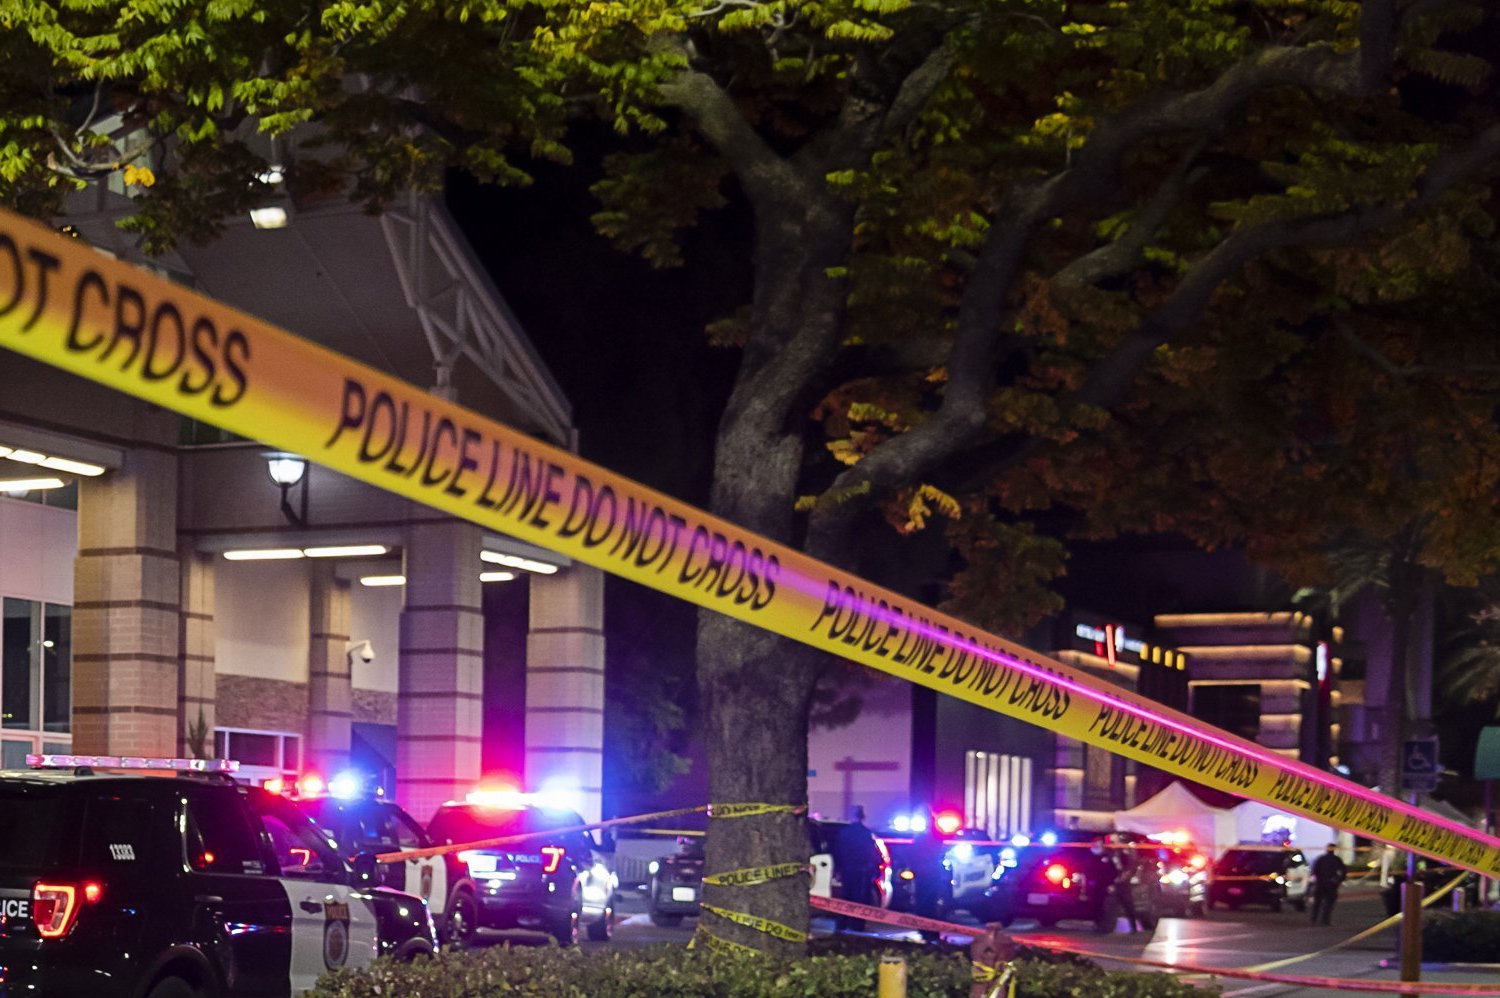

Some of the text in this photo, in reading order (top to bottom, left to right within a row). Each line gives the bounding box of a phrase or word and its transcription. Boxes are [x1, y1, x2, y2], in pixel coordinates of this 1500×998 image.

[66, 270, 252, 409] CROSS
[324, 377, 781, 611] POLICE LINE DO NOT CROSS
[809, 579, 1074, 721] POLICE LINE DO NOT CROSS
[718, 870, 761, 886] POLICE
[765, 865, 792, 880] LINE
